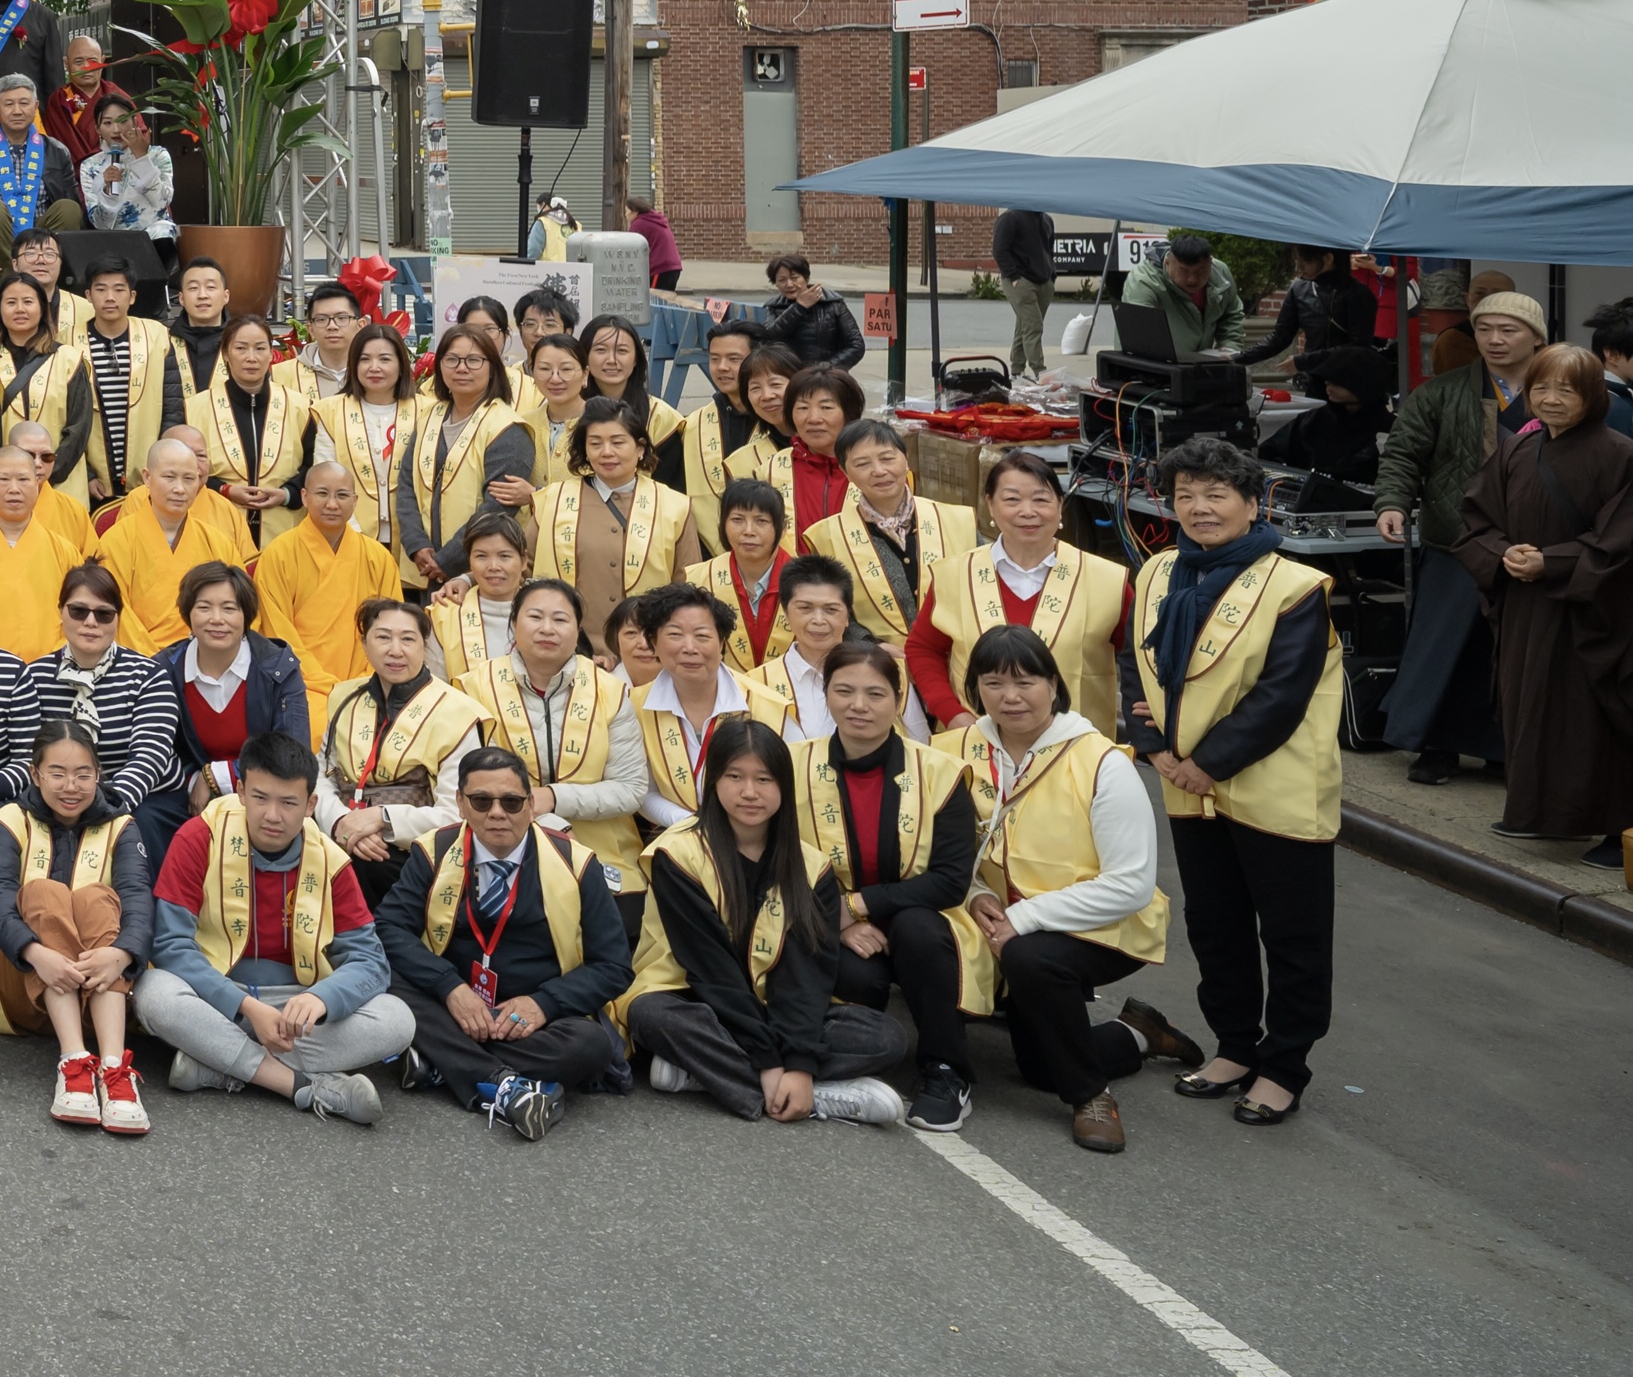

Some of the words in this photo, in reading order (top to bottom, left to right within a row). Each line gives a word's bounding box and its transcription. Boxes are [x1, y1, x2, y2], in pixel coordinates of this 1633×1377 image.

[600, 302, 644, 312] SAMPLING
[605, 287, 638, 297] WATER
[217, 397, 240, 460] 梵音寺
[263, 396, 283, 459] 普陀山
[349, 412, 371, 479] 梵音寺
[560, 496, 580, 574] 梵音寺
[626, 494, 650, 568] 普陀山
[850, 529, 894, 612] 梵音寺
[1197, 569, 1259, 659] 普陀山
[496, 667, 531, 756] 梵音寺
[565, 669, 591, 757] 普陀山
[815, 761, 846, 867] 梵音寺
[228, 834, 249, 938] 梵音寺
[294, 872, 319, 972] 普陀山
[433, 844, 466, 943] 梵音寺
